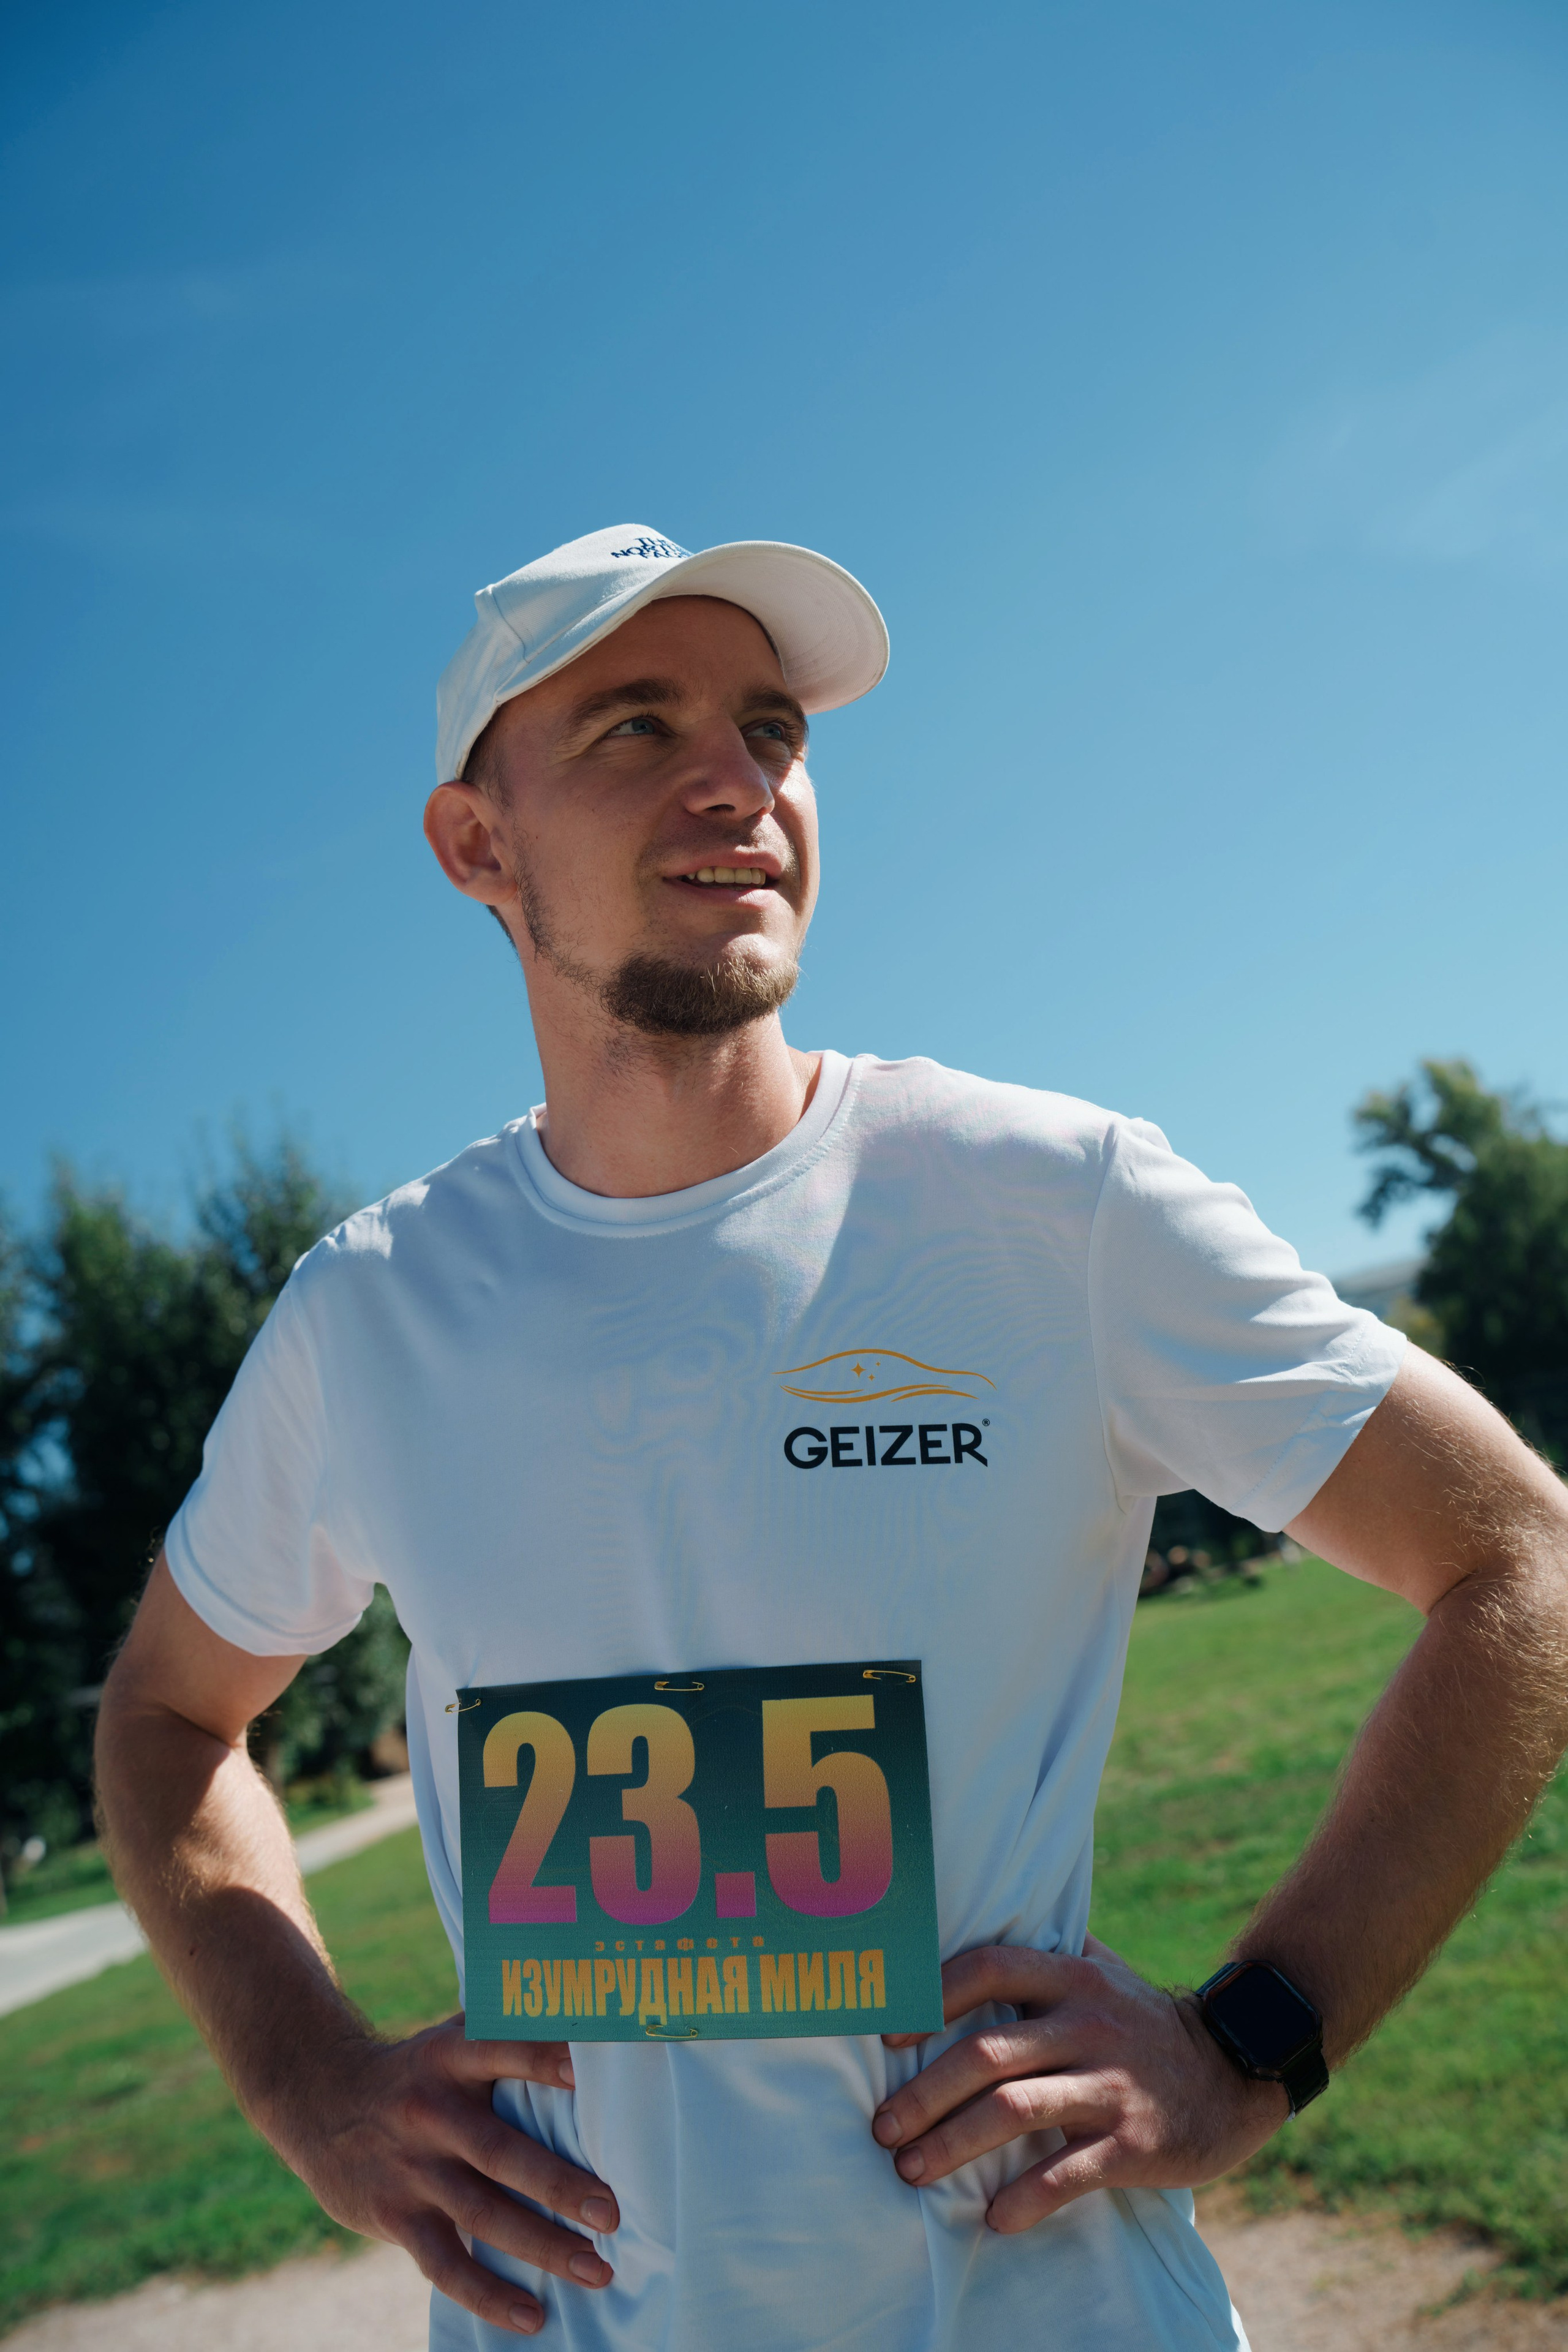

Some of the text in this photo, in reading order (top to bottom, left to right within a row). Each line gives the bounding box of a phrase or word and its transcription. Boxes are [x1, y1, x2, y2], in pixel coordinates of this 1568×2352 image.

[483, 1695, 893, 1925] 23.5
[502, 1949, 886, 2025] ИЗУМРУДНАЯ МИЛЯ
